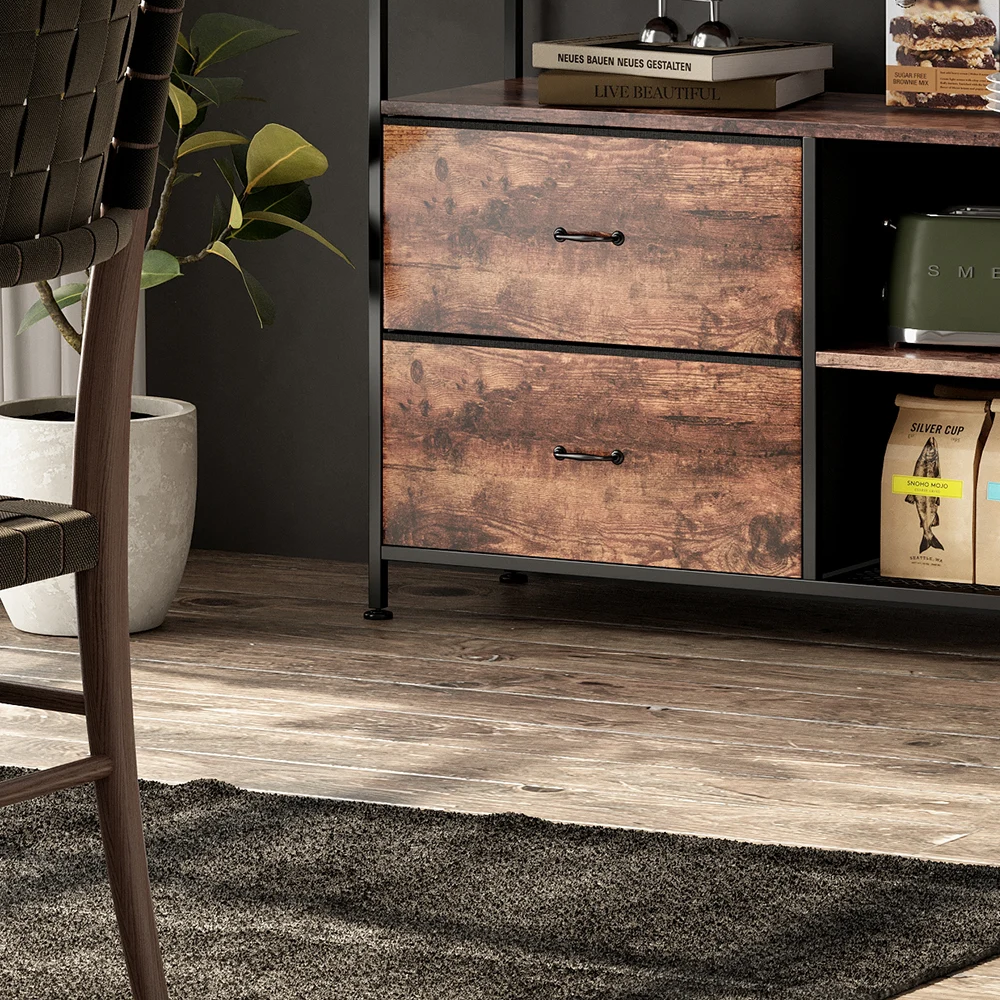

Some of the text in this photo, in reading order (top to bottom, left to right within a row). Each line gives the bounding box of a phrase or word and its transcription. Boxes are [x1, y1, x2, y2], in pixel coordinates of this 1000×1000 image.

[557, 53, 692, 72] NEUES BAUEN NEUES GESTALTEN
[594, 85, 720, 101] LIVE BEAUTIFUL
[910, 422, 965, 436] SILVER CUP
